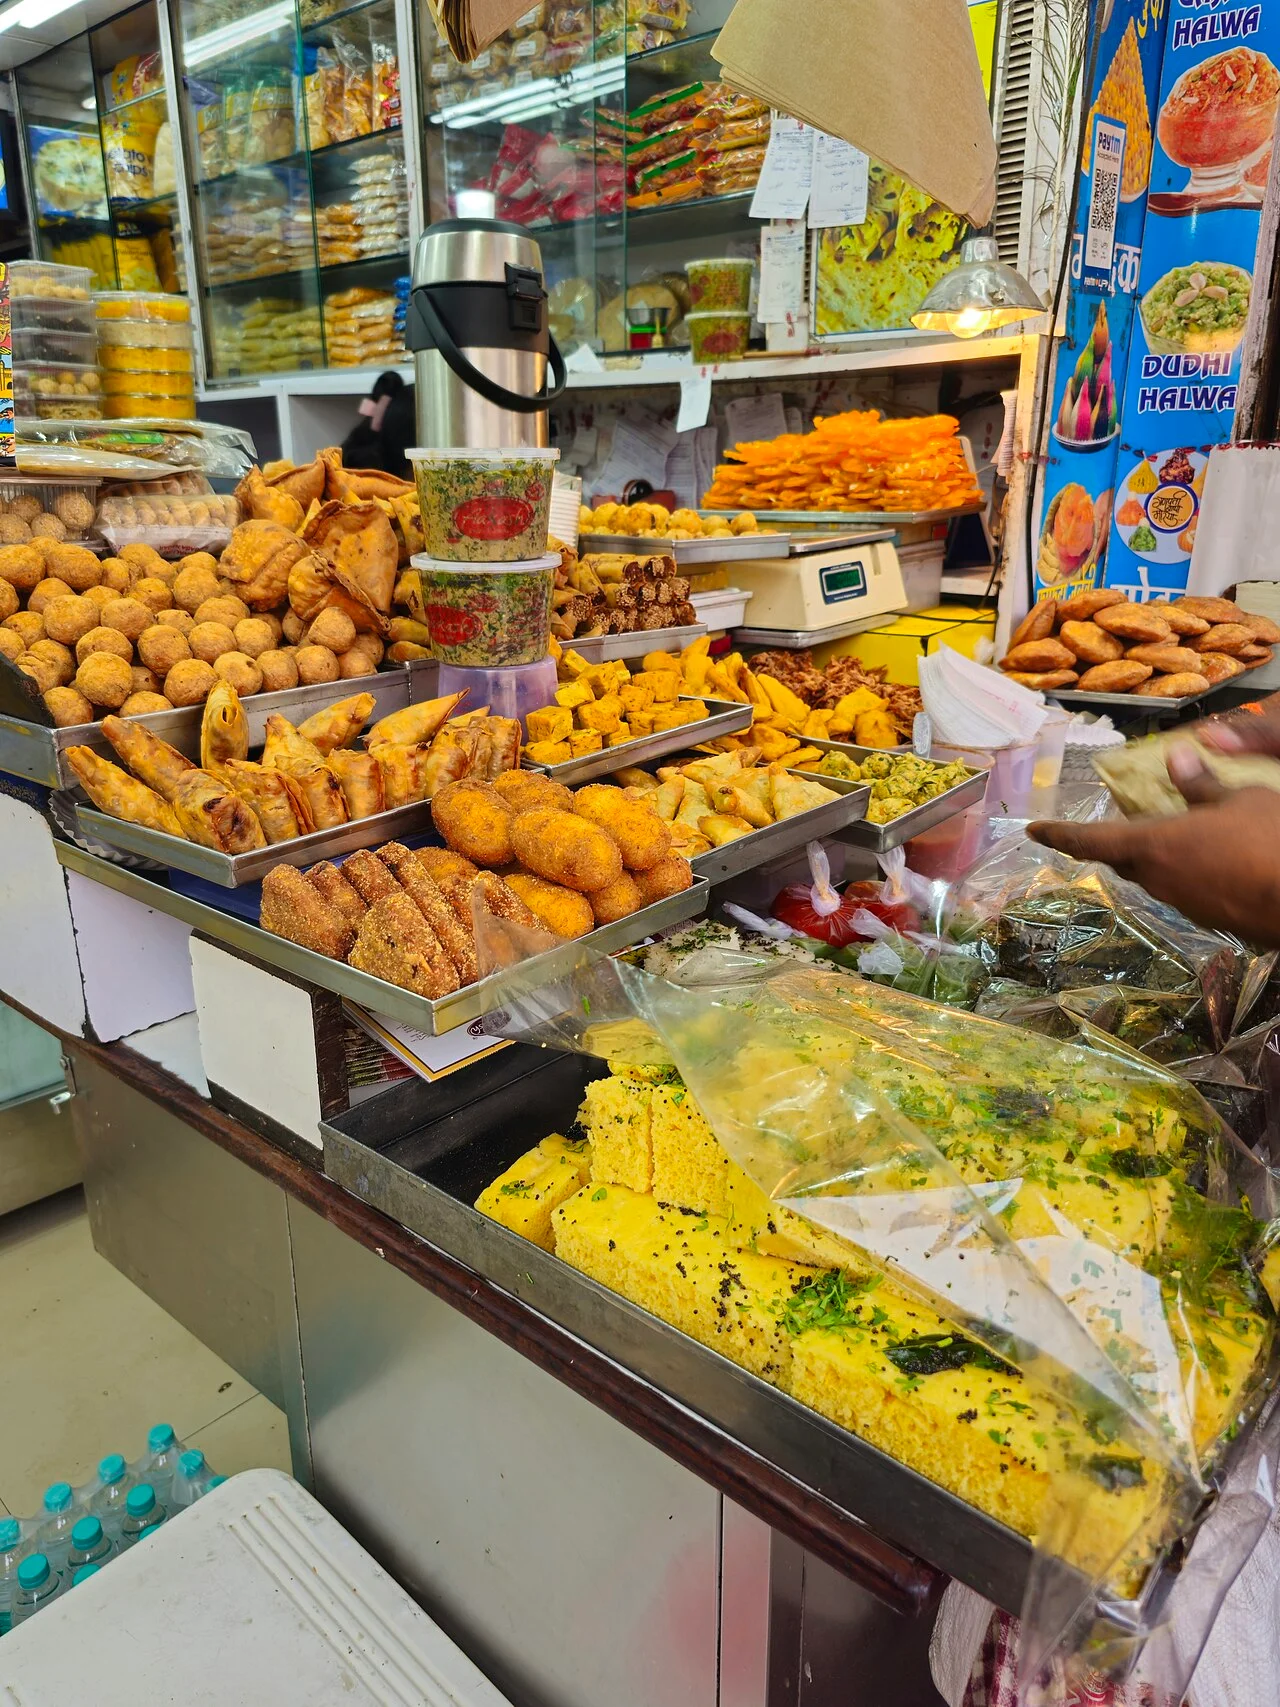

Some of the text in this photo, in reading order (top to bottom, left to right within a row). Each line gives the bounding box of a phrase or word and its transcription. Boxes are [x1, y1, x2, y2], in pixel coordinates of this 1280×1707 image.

[1173, 4, 1261, 51] HALWA
[1141, 352, 1232, 380] DUDHI
[1137, 385, 1238, 414] HALWA
